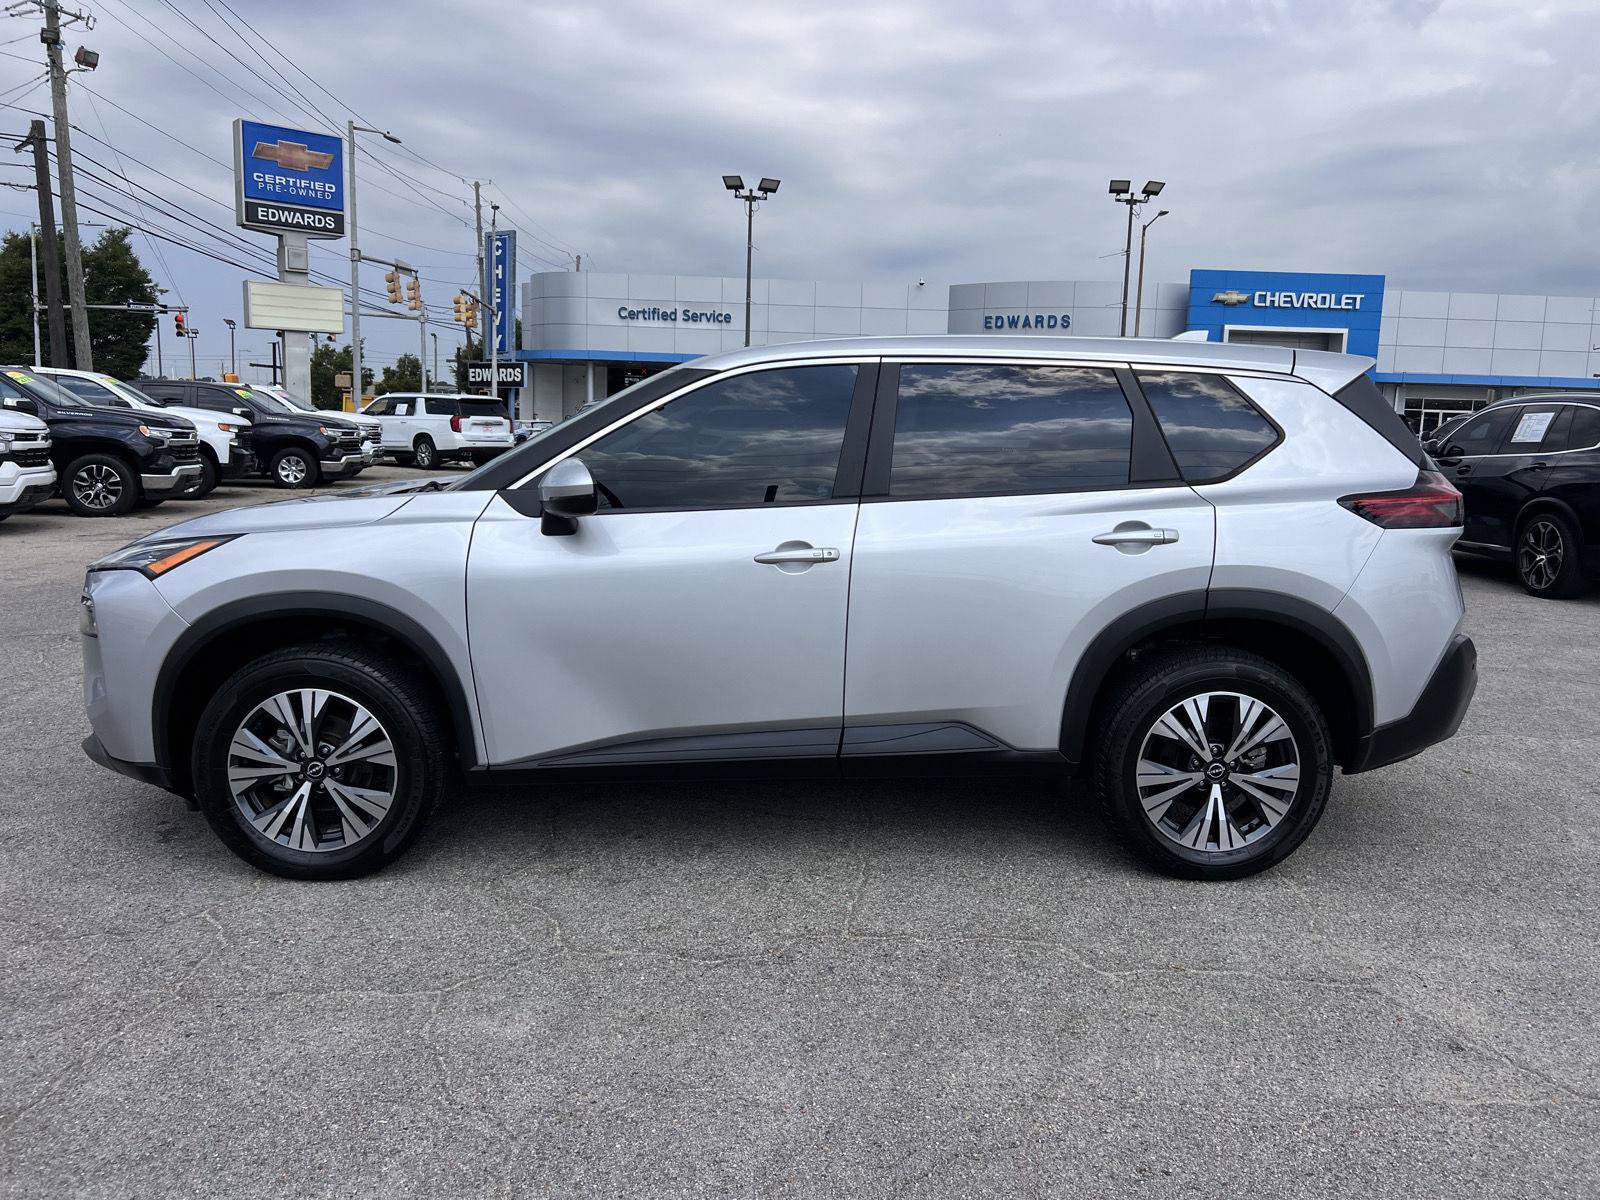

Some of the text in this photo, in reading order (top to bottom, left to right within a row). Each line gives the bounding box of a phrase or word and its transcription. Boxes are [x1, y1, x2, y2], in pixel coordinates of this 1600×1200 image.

[253, 172, 336, 193] CERTIFIED
[258, 182, 332, 200] PRE-OWNED
[257, 207, 335, 229] EDWARDS
[1253, 291, 1365, 310] CHEVROLET
[617, 306, 732, 324] Certified Service
[983, 314, 1071, 330] EDWARDS
